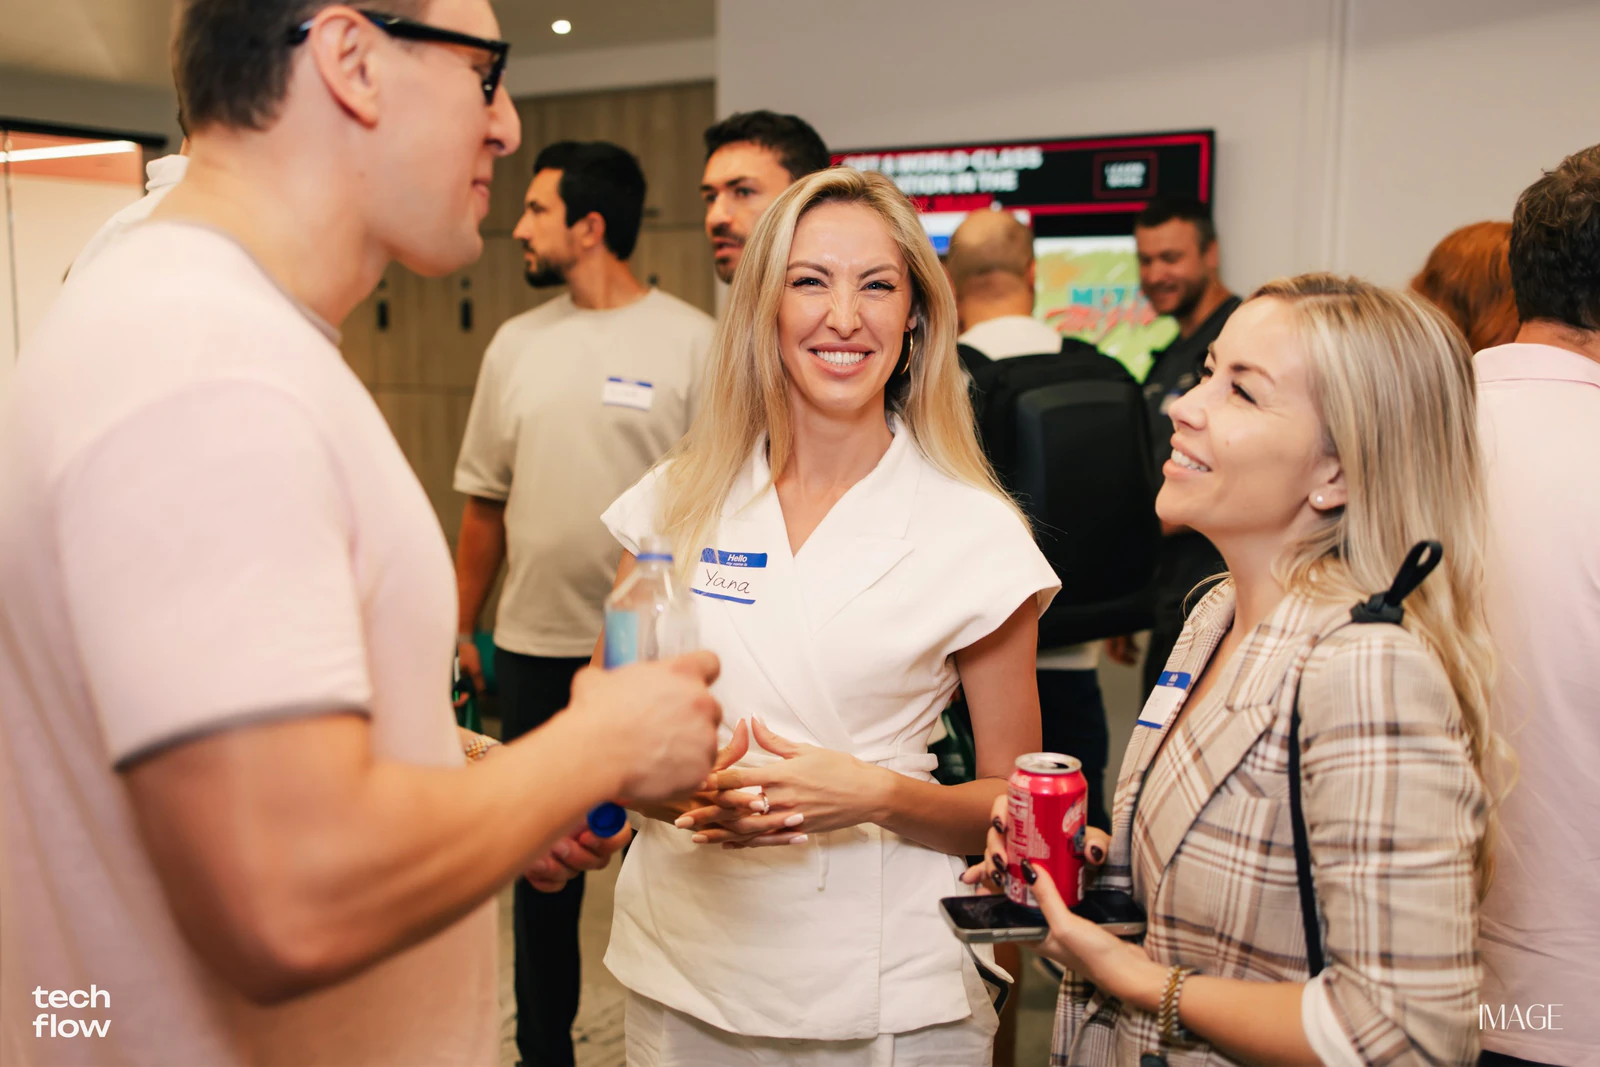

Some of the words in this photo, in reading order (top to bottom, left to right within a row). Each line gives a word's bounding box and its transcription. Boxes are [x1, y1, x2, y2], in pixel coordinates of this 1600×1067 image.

[978, 170, 1018, 193] THE
[727, 554, 747, 563] Hello
[705, 568, 750, 594] Yana
